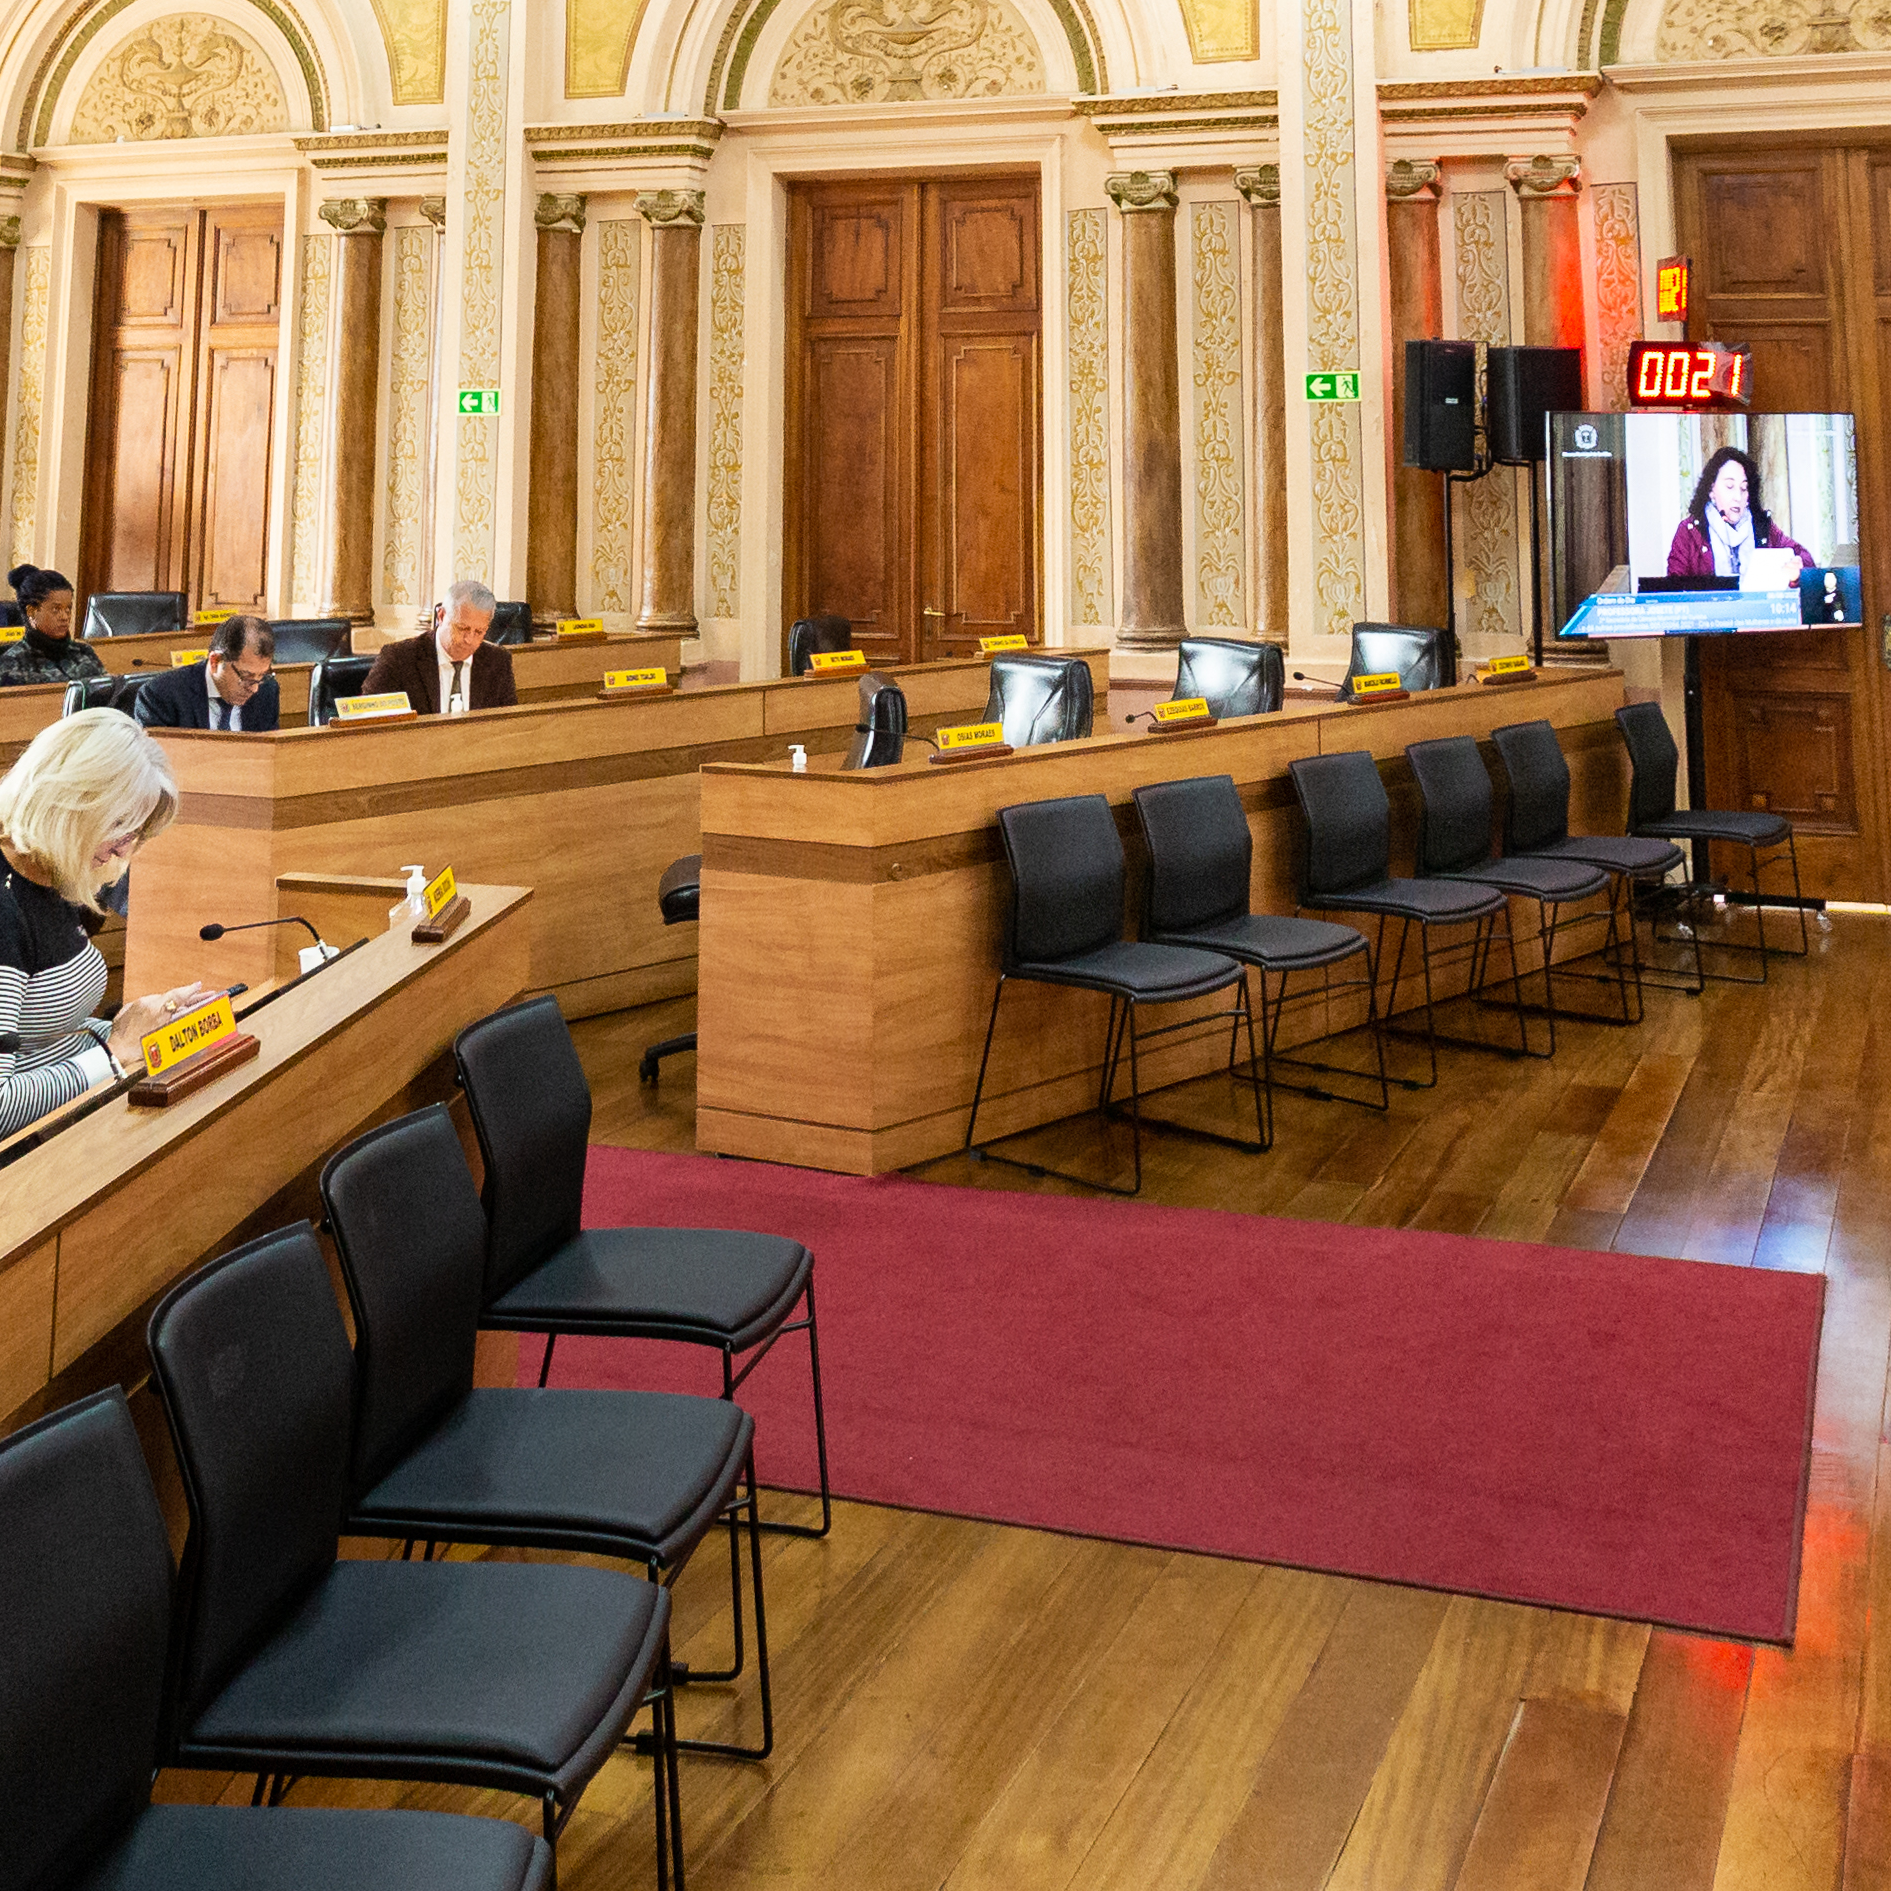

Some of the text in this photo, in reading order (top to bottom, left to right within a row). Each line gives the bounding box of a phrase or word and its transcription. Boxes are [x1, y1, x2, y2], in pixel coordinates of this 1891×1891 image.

[1638, 351, 1743, 398] 0021
[1770, 603, 1798, 615] 10:14
[169, 1011, 223, 1053] DALTON BORBA
